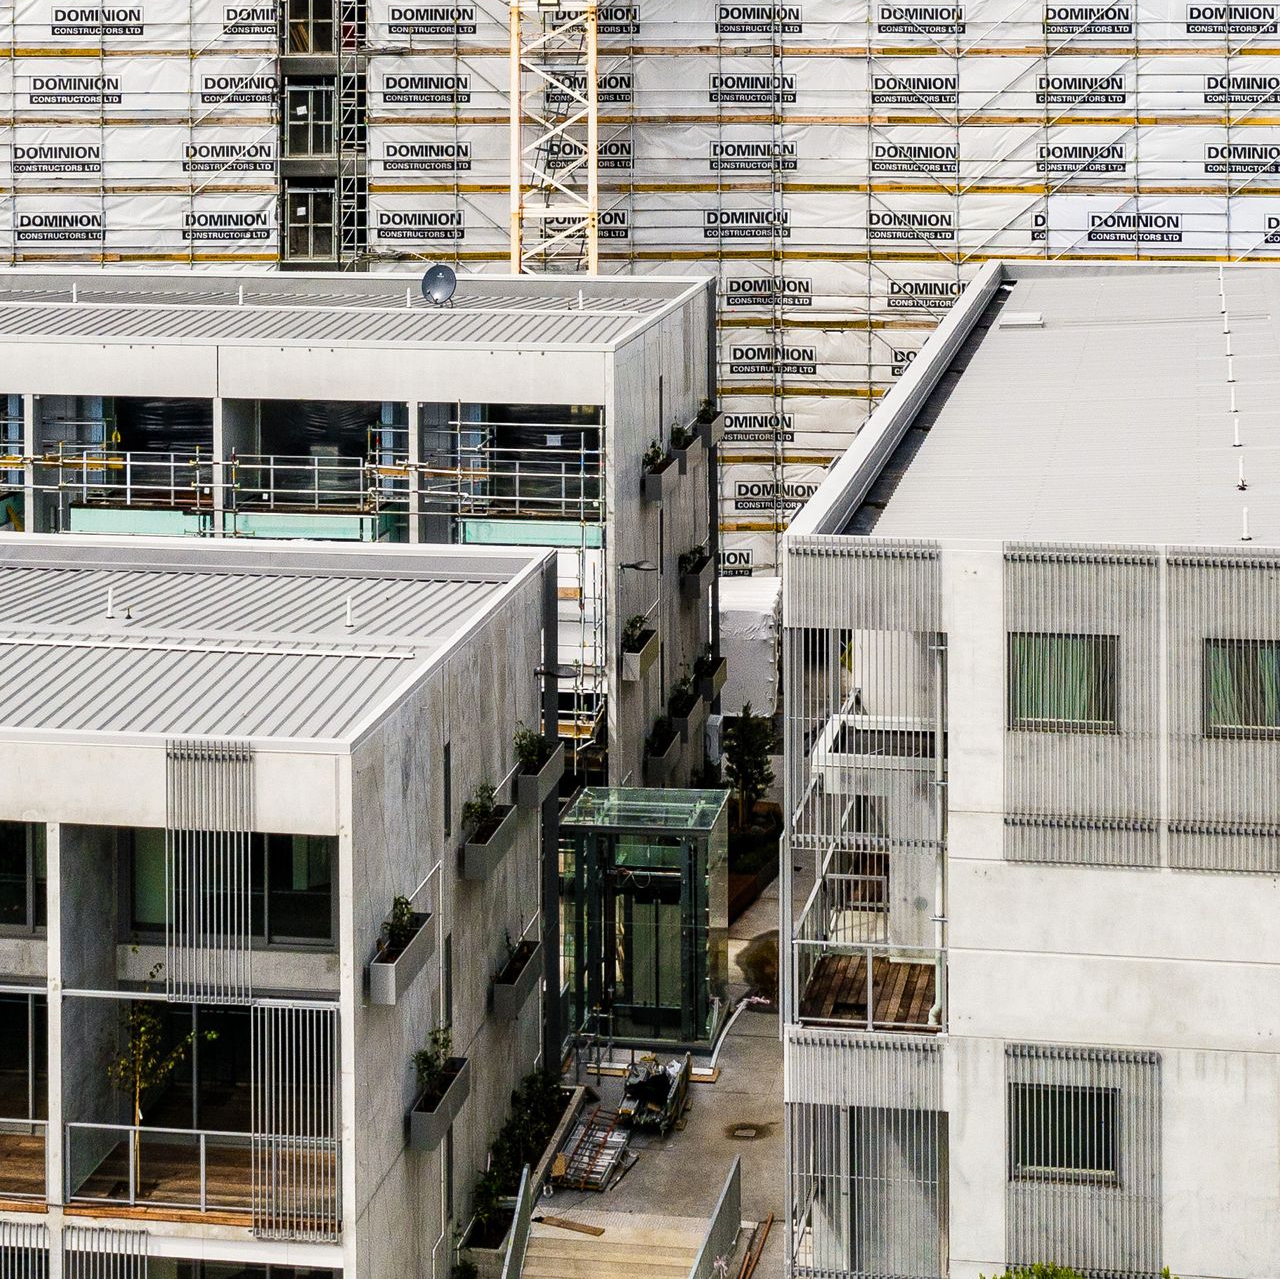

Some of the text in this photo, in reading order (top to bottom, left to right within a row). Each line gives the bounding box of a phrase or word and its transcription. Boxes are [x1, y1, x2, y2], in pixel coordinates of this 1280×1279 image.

[55, 9, 140, 21] DOMINION
[392, 8, 473, 20] DOMINION
[1190, 7, 1274, 19] DOMINION
[33, 78, 119, 90] DOMINION
[386, 77, 467, 89] DOMINION
[14, 146, 99, 159] DOMINION
[387, 145, 468, 157] DOMINION
[20, 215, 102, 227] DOMINION
[380, 213, 461, 225] DOMINION
